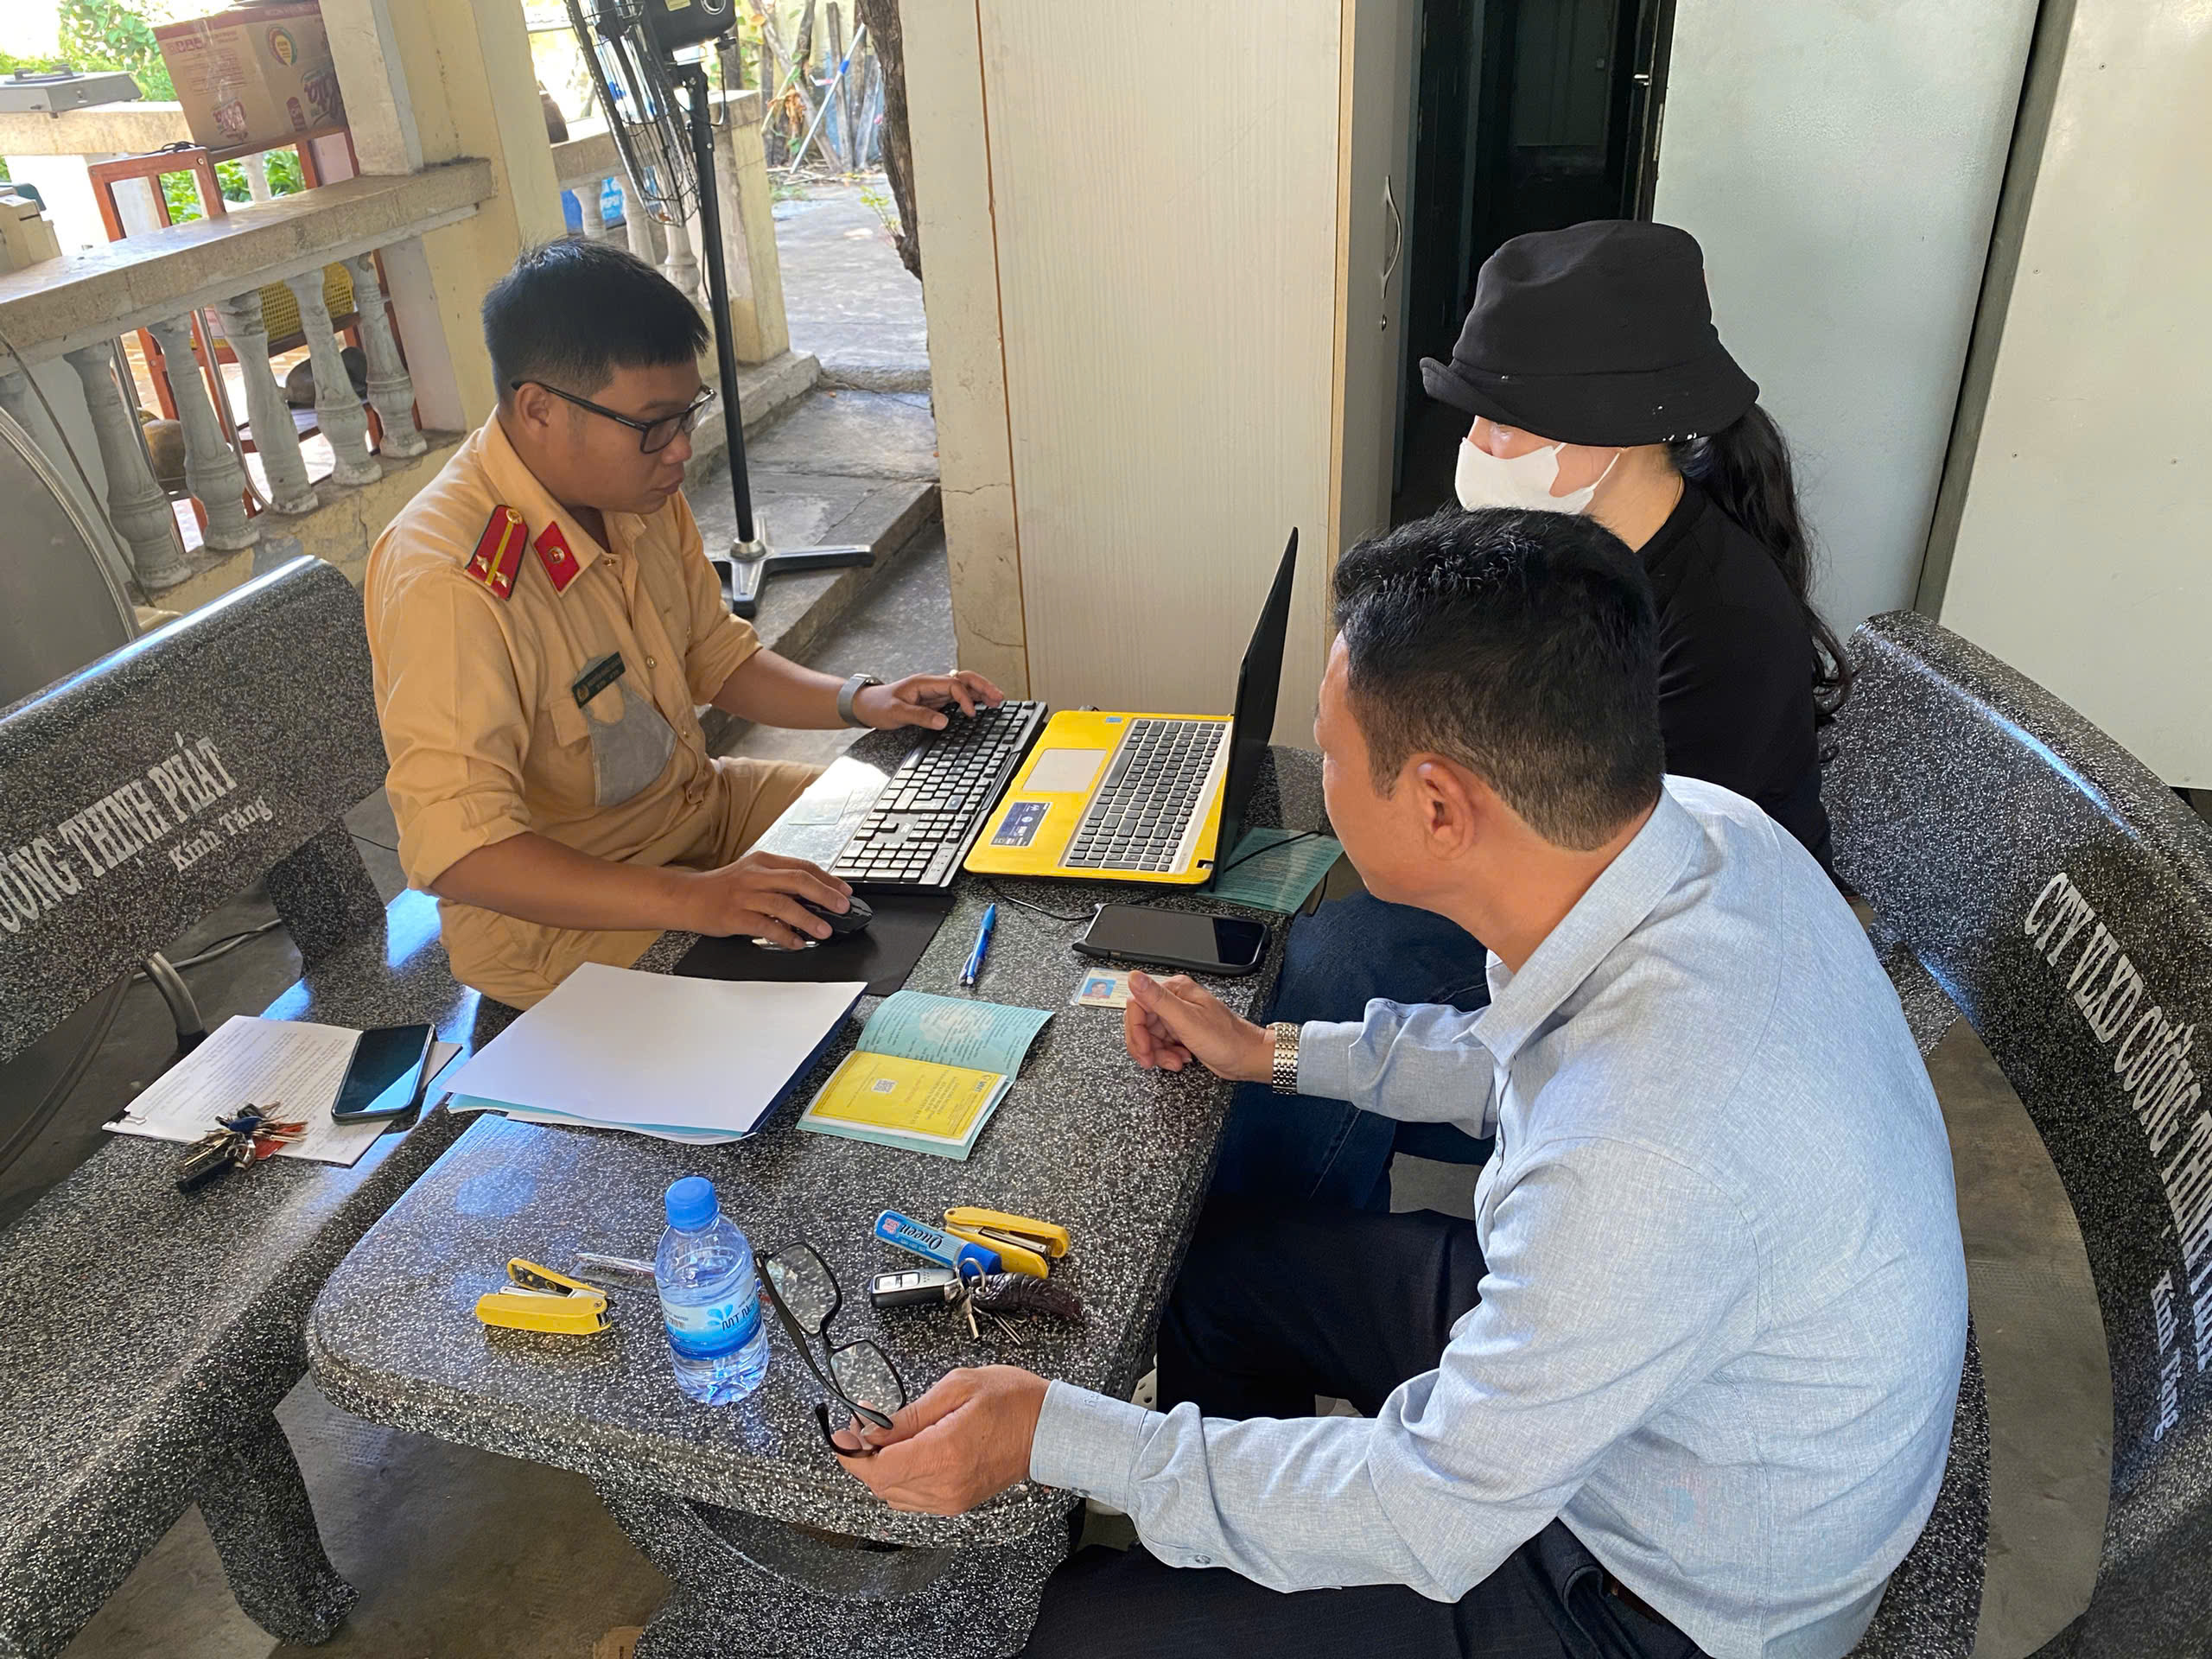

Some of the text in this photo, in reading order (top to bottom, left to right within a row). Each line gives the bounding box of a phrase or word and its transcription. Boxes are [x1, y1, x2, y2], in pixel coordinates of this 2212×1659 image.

[147, 731, 238, 823] PHÁT
[168, 828, 222, 874] Kính
[2024, 872, 2096, 968] CTY
[2066, 921, 2144, 1044] VLXD
[899, 1223, 944, 1251] Queen
